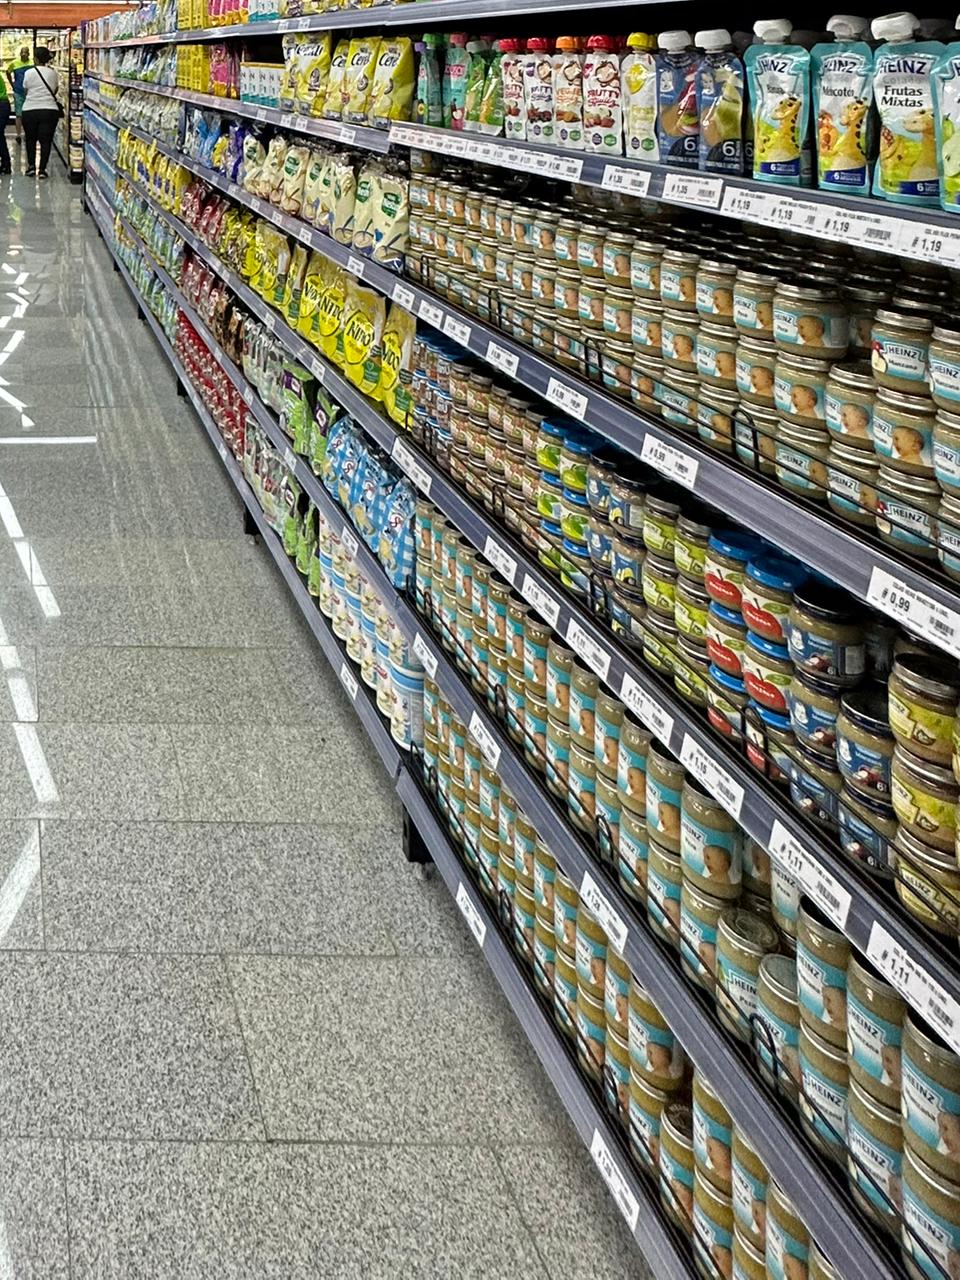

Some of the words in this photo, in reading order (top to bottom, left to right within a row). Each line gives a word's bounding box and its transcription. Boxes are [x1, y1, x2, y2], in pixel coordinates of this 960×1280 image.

[883, 85, 923, 97] Frutas
[881, 96, 924, 108] Mixtas
[684, 137, 696, 151] 6
[723, 141, 735, 157] 6
[831, 220, 850, 233] 1,19
[921, 236, 942, 253] 1,19
[888, 346, 919, 360] HEINZ
[892, 507, 924, 523] HEINZ
[889, 591, 911, 612] 0,99
[788, 849, 803, 871] 1,11
[891, 958, 910, 985] 1,11
[850, 1010, 882, 1037] HEINZ
